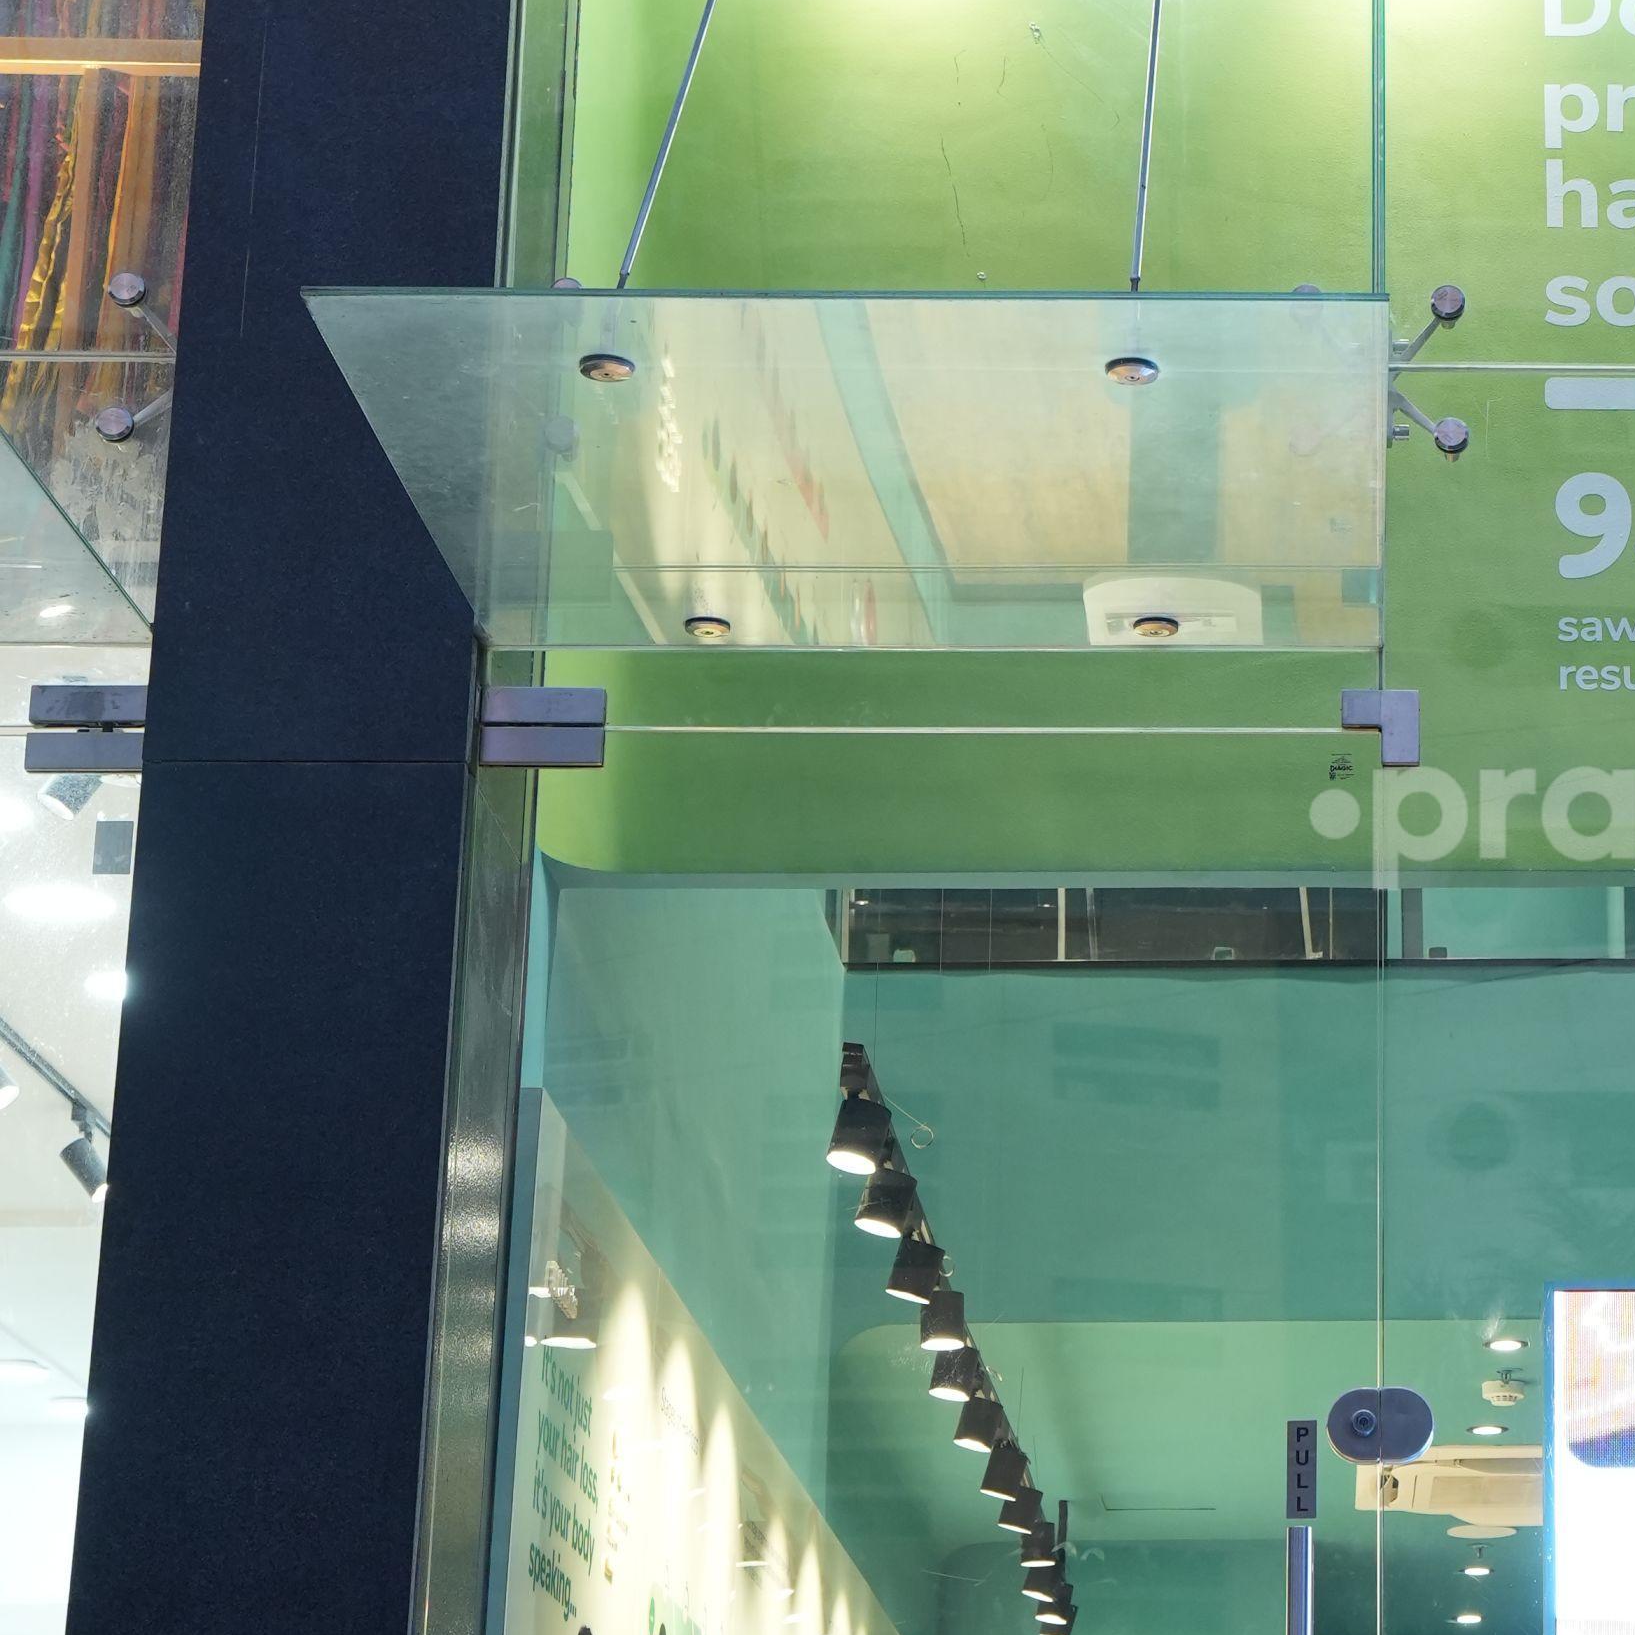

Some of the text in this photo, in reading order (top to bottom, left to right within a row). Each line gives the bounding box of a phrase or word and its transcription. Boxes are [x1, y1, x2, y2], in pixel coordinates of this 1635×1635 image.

[558, 1368, 574, 1415] not
[573, 1375, 592, 1438] just
[537, 1409, 599, 1513] your hair loss,
[1296, 1427, 1309, 1512] PULL
[532, 1460, 595, 1576] it's your body
[528, 1542, 577, 1622] speaking...
